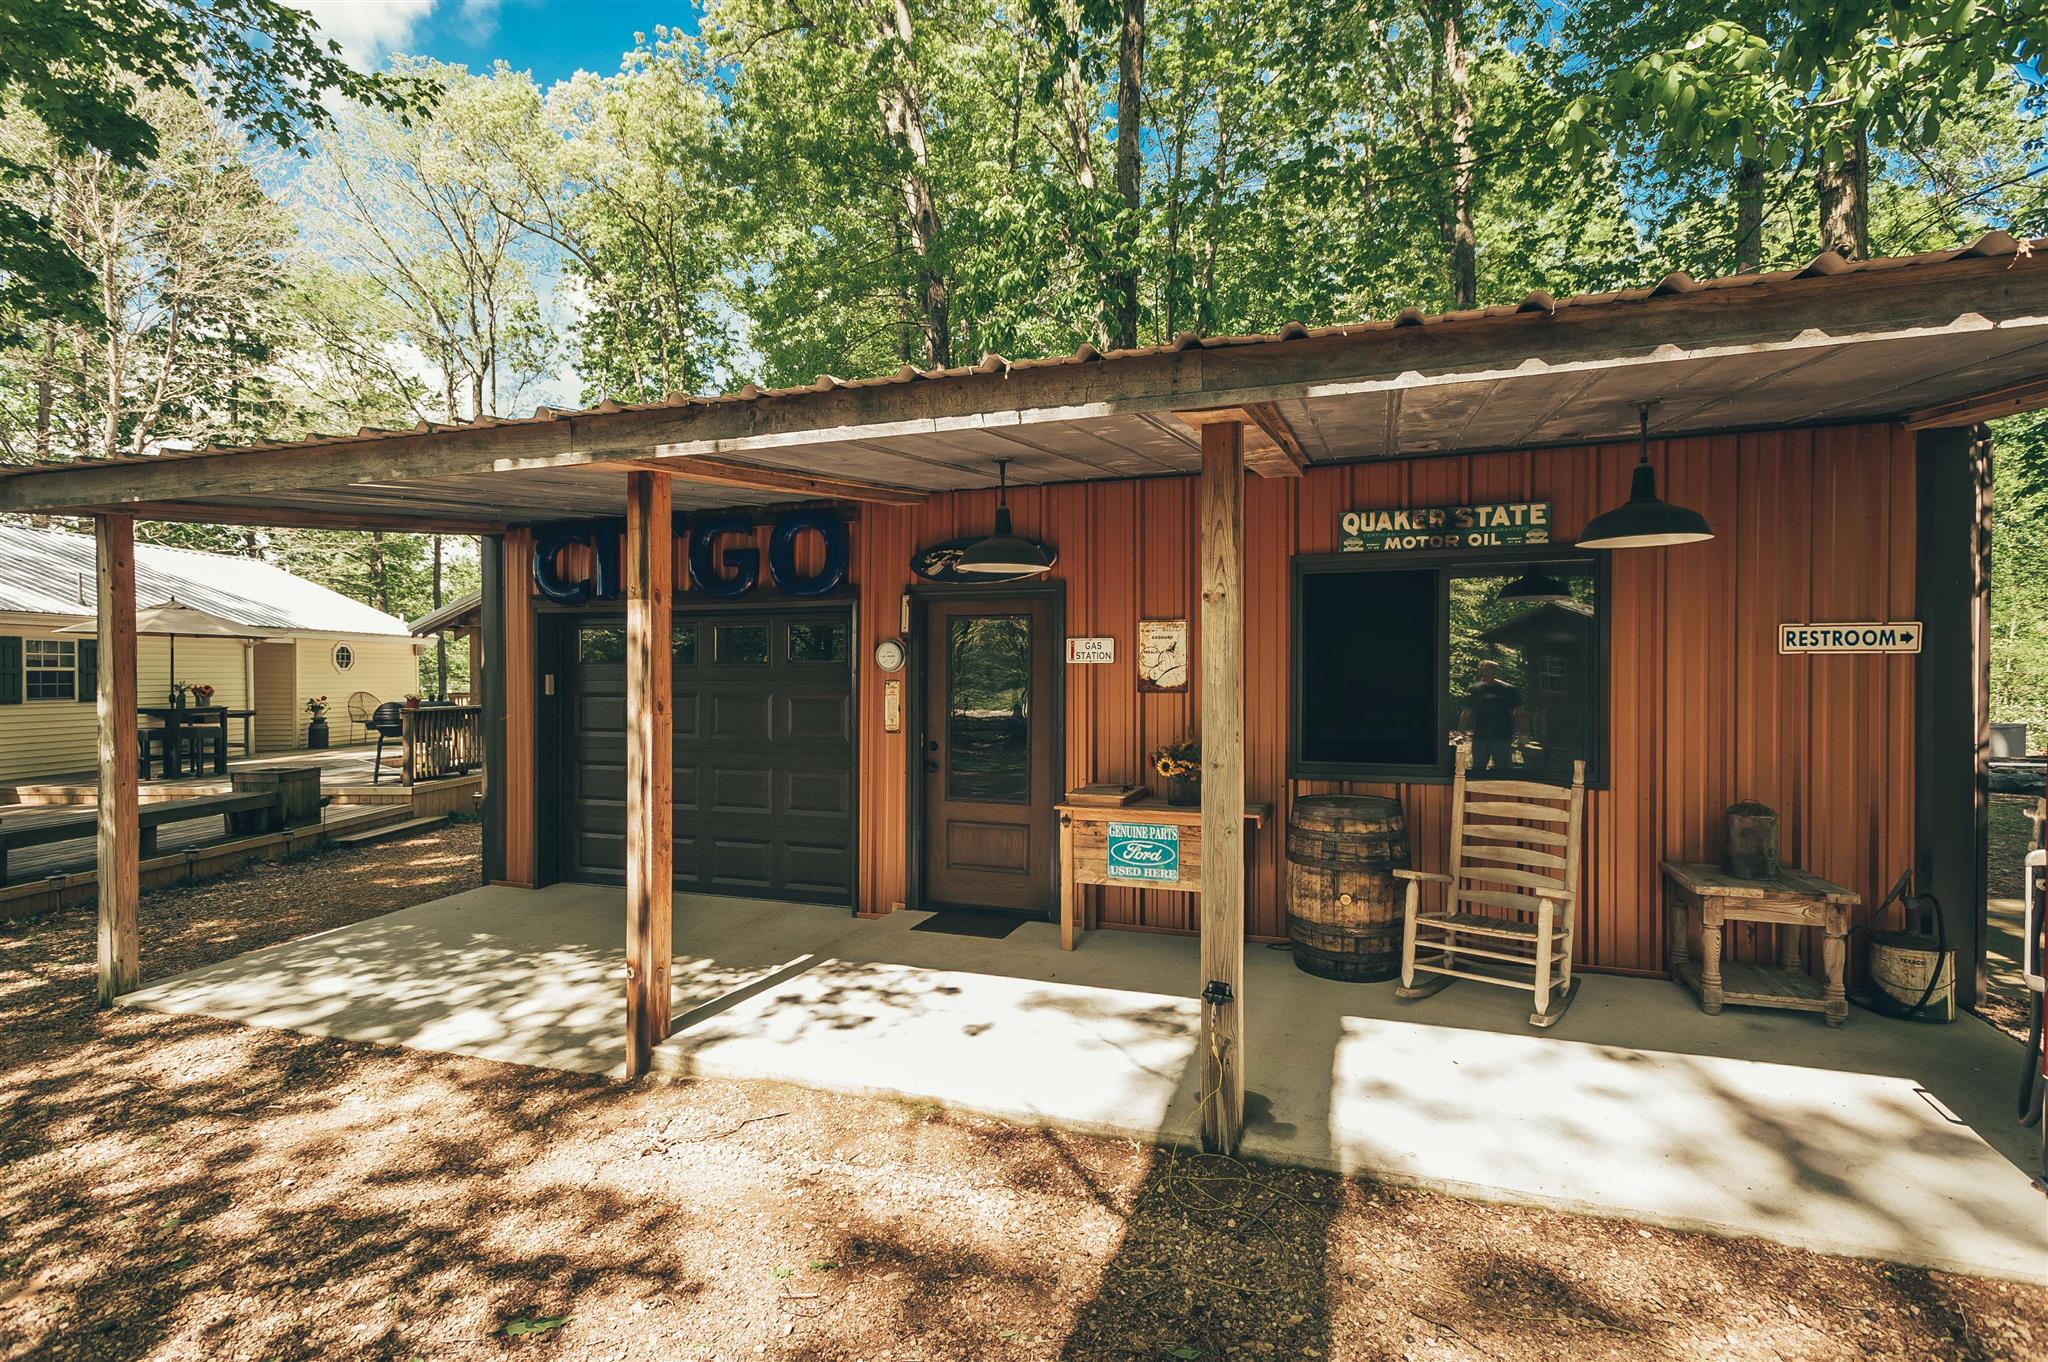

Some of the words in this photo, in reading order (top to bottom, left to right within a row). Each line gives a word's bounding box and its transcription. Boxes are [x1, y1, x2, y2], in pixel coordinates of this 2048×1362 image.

[1342, 508, 1446, 536] QUAKER
[1455, 503, 1547, 528] STATE
[1384, 534, 1460, 550] MOTOR
[1467, 532, 1502, 547] OIL
[533, 509, 849, 606] CIGO
[1085, 641, 1102, 650] GAS
[1785, 629, 1897, 647] RESTROOM
[1075, 651, 1112, 660] STATION
[1109, 825, 1148, 839] GENUINE
[1148, 827, 1178, 840] PARTS
[1123, 842, 1162, 861] Ford
[1110, 865, 1141, 876] USED
[1144, 868, 1177, 879] HERE
[1900, 957, 1926, 966] TEXACO
